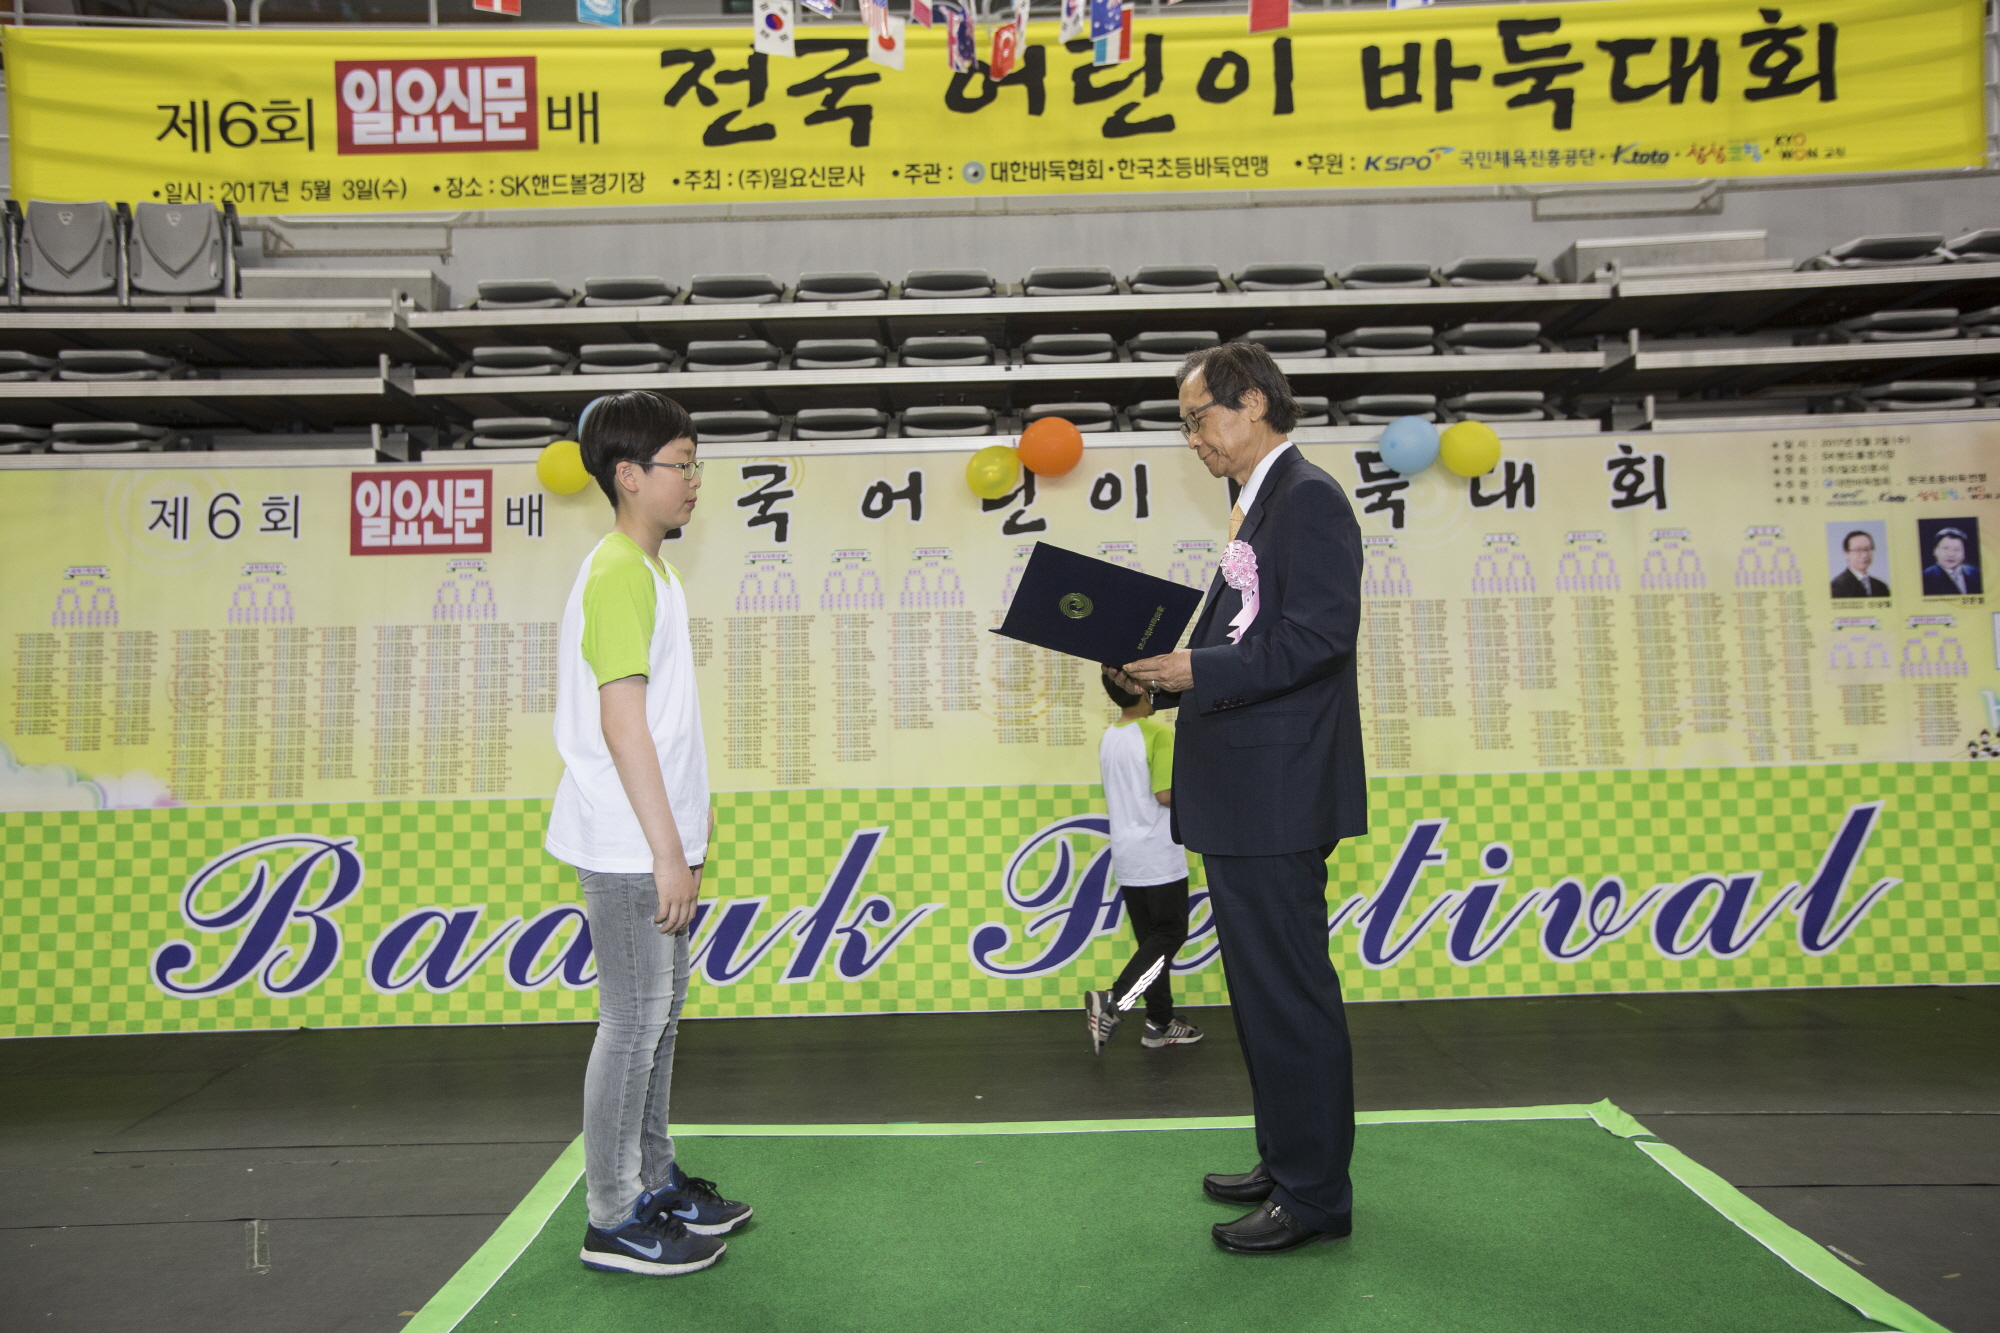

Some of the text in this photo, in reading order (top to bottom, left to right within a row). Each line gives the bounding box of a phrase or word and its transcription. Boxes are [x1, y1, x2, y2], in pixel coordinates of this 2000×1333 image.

[156, 98, 315, 153] 제6회
[342, 66, 528, 145] 일요신문
[547, 91, 599, 145] 배
[661, 38, 881, 147] 전국
[1361, 8, 1838, 131] 바둑대회
[1364, 154, 1433, 172] KSPO
[500, 172, 646, 197] SK핸드볼경기장
[738, 165, 866, 190] (주)일요신문사
[221, 180, 289, 203] 2017년
[301, 180, 331, 201] 5월
[355, 479, 485, 548] 일요신문
[506, 493, 543, 537] 배
[970, 800, 1898, 981] Fetival
